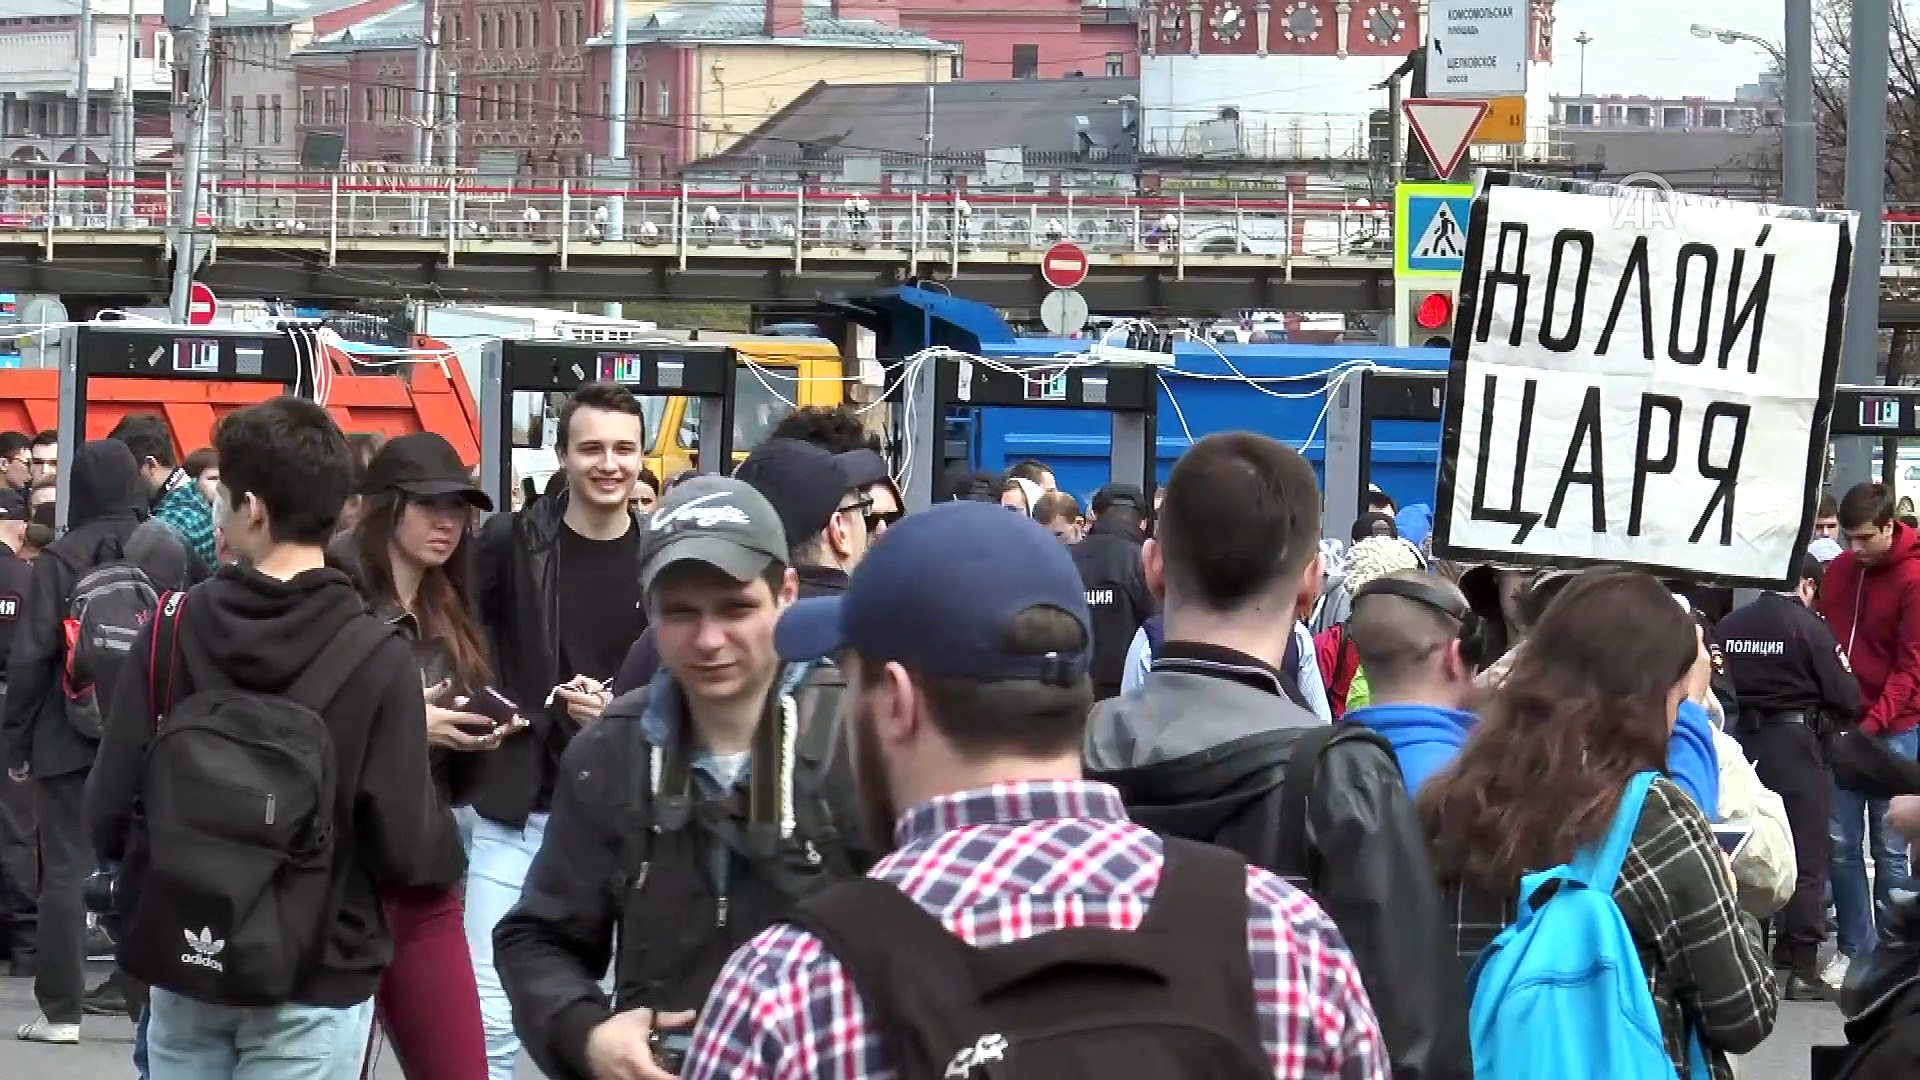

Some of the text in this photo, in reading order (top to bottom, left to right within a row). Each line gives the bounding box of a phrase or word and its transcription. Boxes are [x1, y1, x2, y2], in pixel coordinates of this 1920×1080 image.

[1448, 7, 1513, 20] КОМСОМОЛЬСКАЯ
[1447, 56, 1497, 69] ЩЕЛКОВСКОЕ
[1475, 221, 1775, 374] ДОЛОЙ
[1471, 374, 1751, 546] ЦАРЯ
[1725, 639, 1784, 656] ПОЛИЦИЯ
[181, 953, 223, 973] adidas
